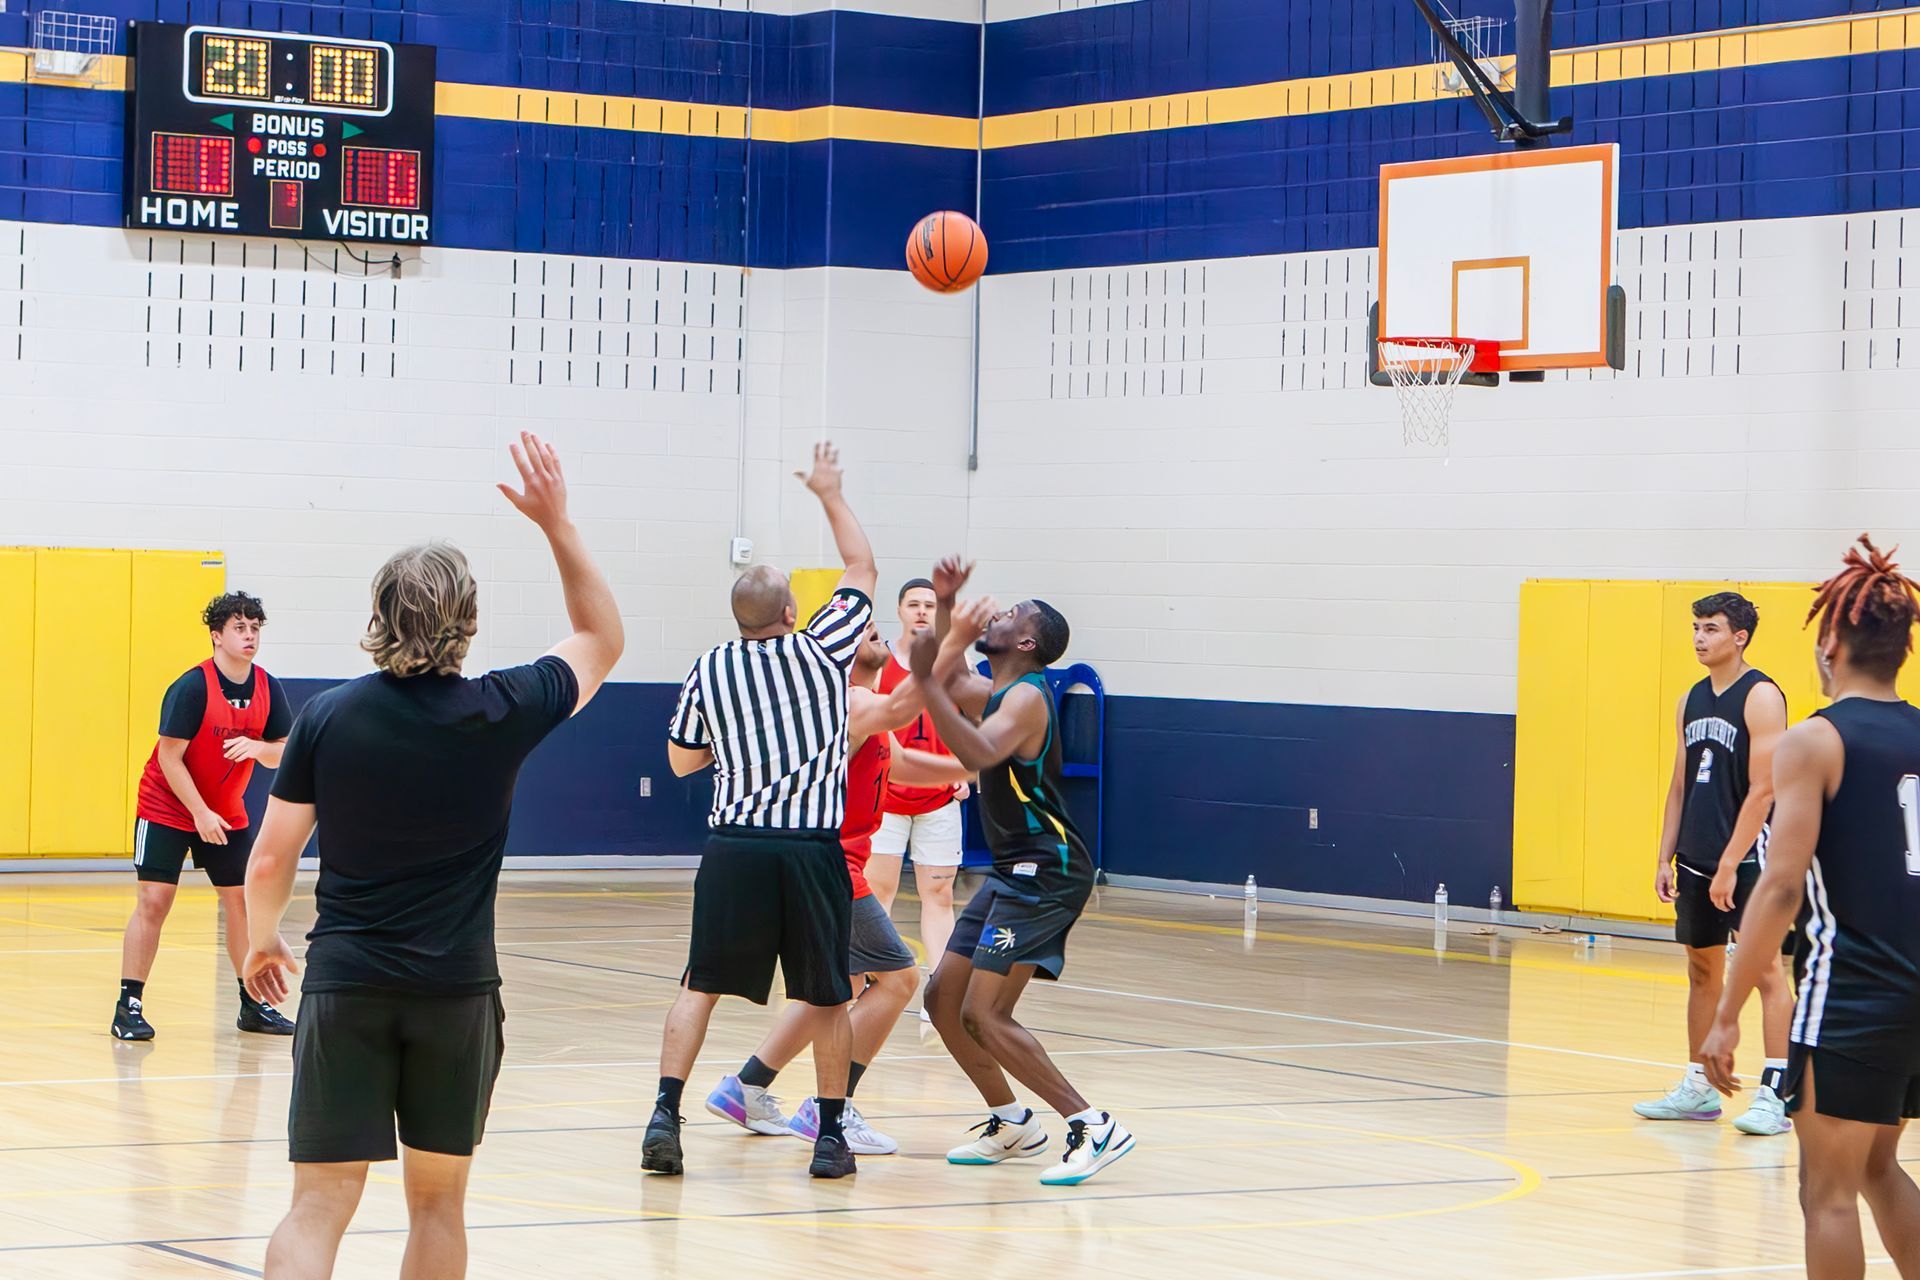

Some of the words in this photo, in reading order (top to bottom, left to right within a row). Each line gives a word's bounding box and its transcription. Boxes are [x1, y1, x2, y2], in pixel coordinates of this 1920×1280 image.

[252, 114, 324, 137] BONUS
[267, 139, 307, 157] POSS
[253, 158, 320, 180] PERIOD
[141, 197, 239, 229] HOME
[323, 208, 429, 240] VISITOR
[1696, 748, 1714, 783] 2
